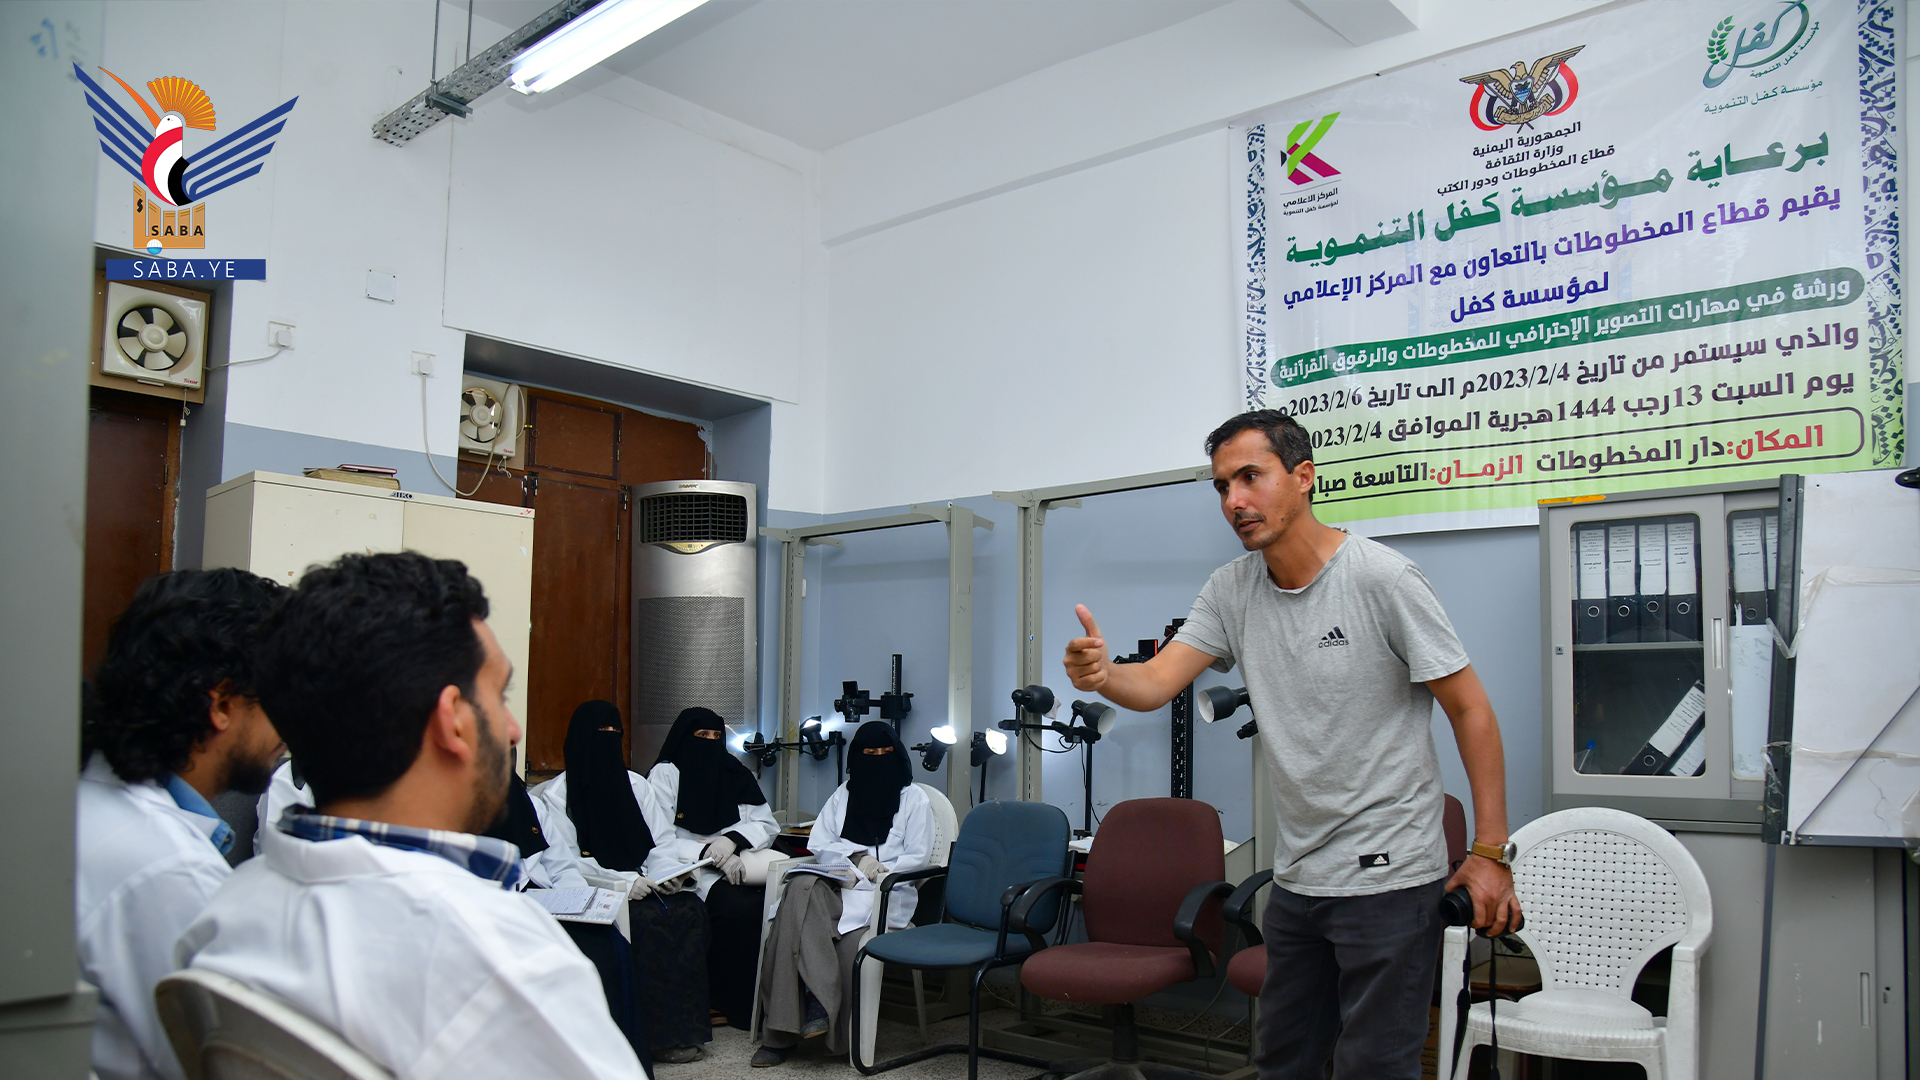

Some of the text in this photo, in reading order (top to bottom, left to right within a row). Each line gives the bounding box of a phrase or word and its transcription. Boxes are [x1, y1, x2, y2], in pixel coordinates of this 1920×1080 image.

[1703, 79, 1823, 115] مؤسسة كفل التنموية
[1472, 121, 1582, 158] الجمهورية اليمنية
[1437, 145, 1616, 197] قطاع المخطوطات ودور الكتب
[1485, 145, 1564, 170] وزارة الثقافة
[1286, 131, 1829, 267] برعاية مؤسسة كفل التنموية
[1316, 187, 1338, 202] المركز
[1283, 185, 1841, 310] يقيم قطاع المخطوطات بالتعاون مع المركز الإعلامي
[1450, 271, 1609, 323] لمؤسسة كفل
[1279, 277, 1851, 382] ورشة في مهارات التصوير الإحترافي للمخطوطات والرقوق القرآنية
[1775, 322, 1859, 356] والذي
[1576, 353, 1626, 385] تاريخ
[1632, 354, 1665, 378] من
[1670, 338, 1767, 373] سيستمر
[1367, 382, 1411, 409] تاريخ
[1416, 377, 1455, 399] الى
[1711, 372, 1794, 405] السبت
[1803, 372, 1854, 399] يوم
[1311, 420, 1382, 450] 023/2/4
[1388, 410, 1480, 442] الموافق
[1536, 438, 1682, 474] المخطوطات
[1312, 475, 1346, 497] صبا
[1318, 639, 1349, 648] adidas
